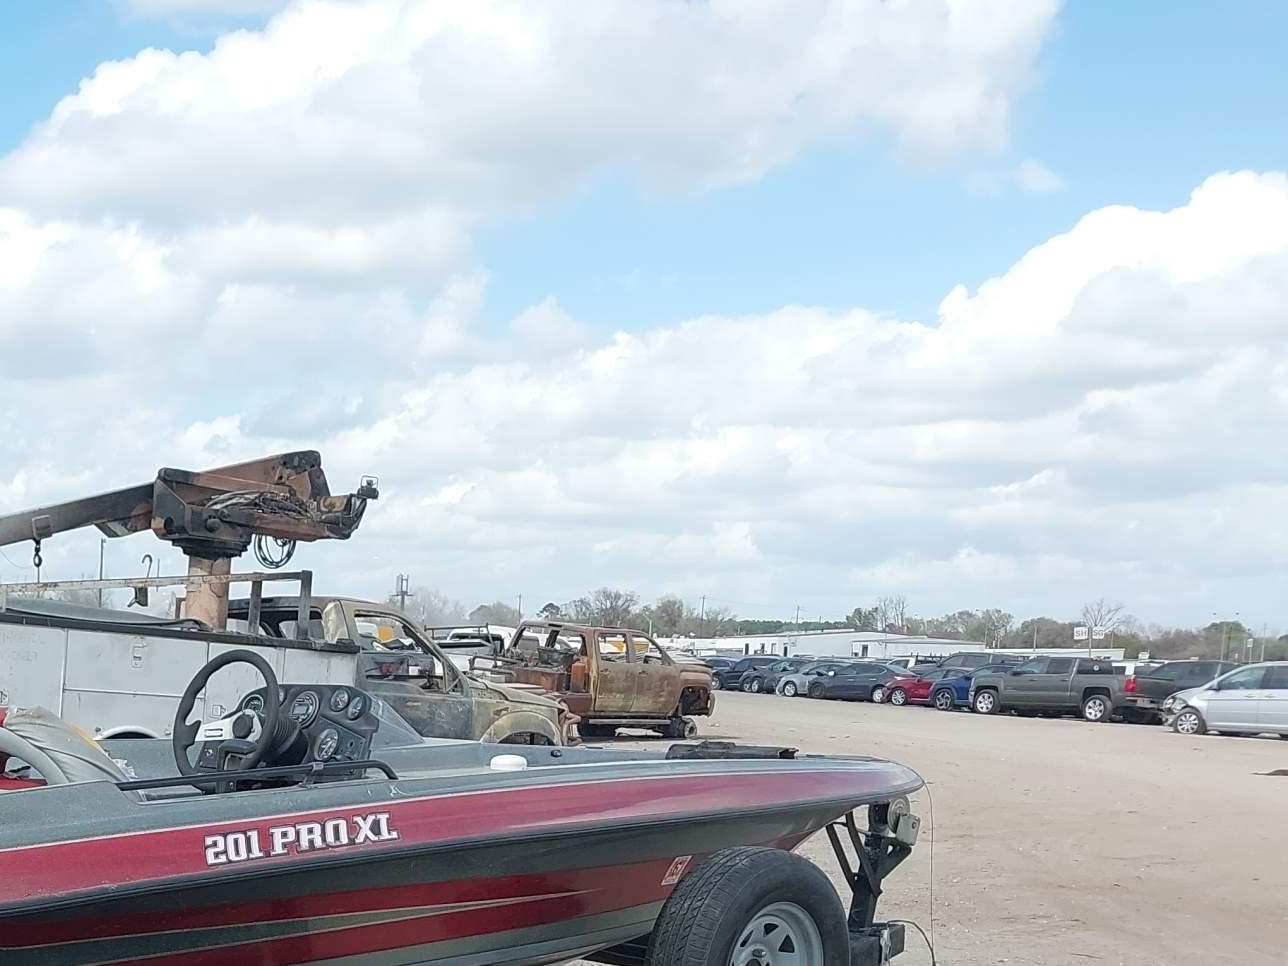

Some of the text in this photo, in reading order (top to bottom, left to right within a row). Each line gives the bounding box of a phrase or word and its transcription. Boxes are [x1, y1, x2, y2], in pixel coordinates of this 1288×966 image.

[204, 812, 399, 866] 201 PRO XL
